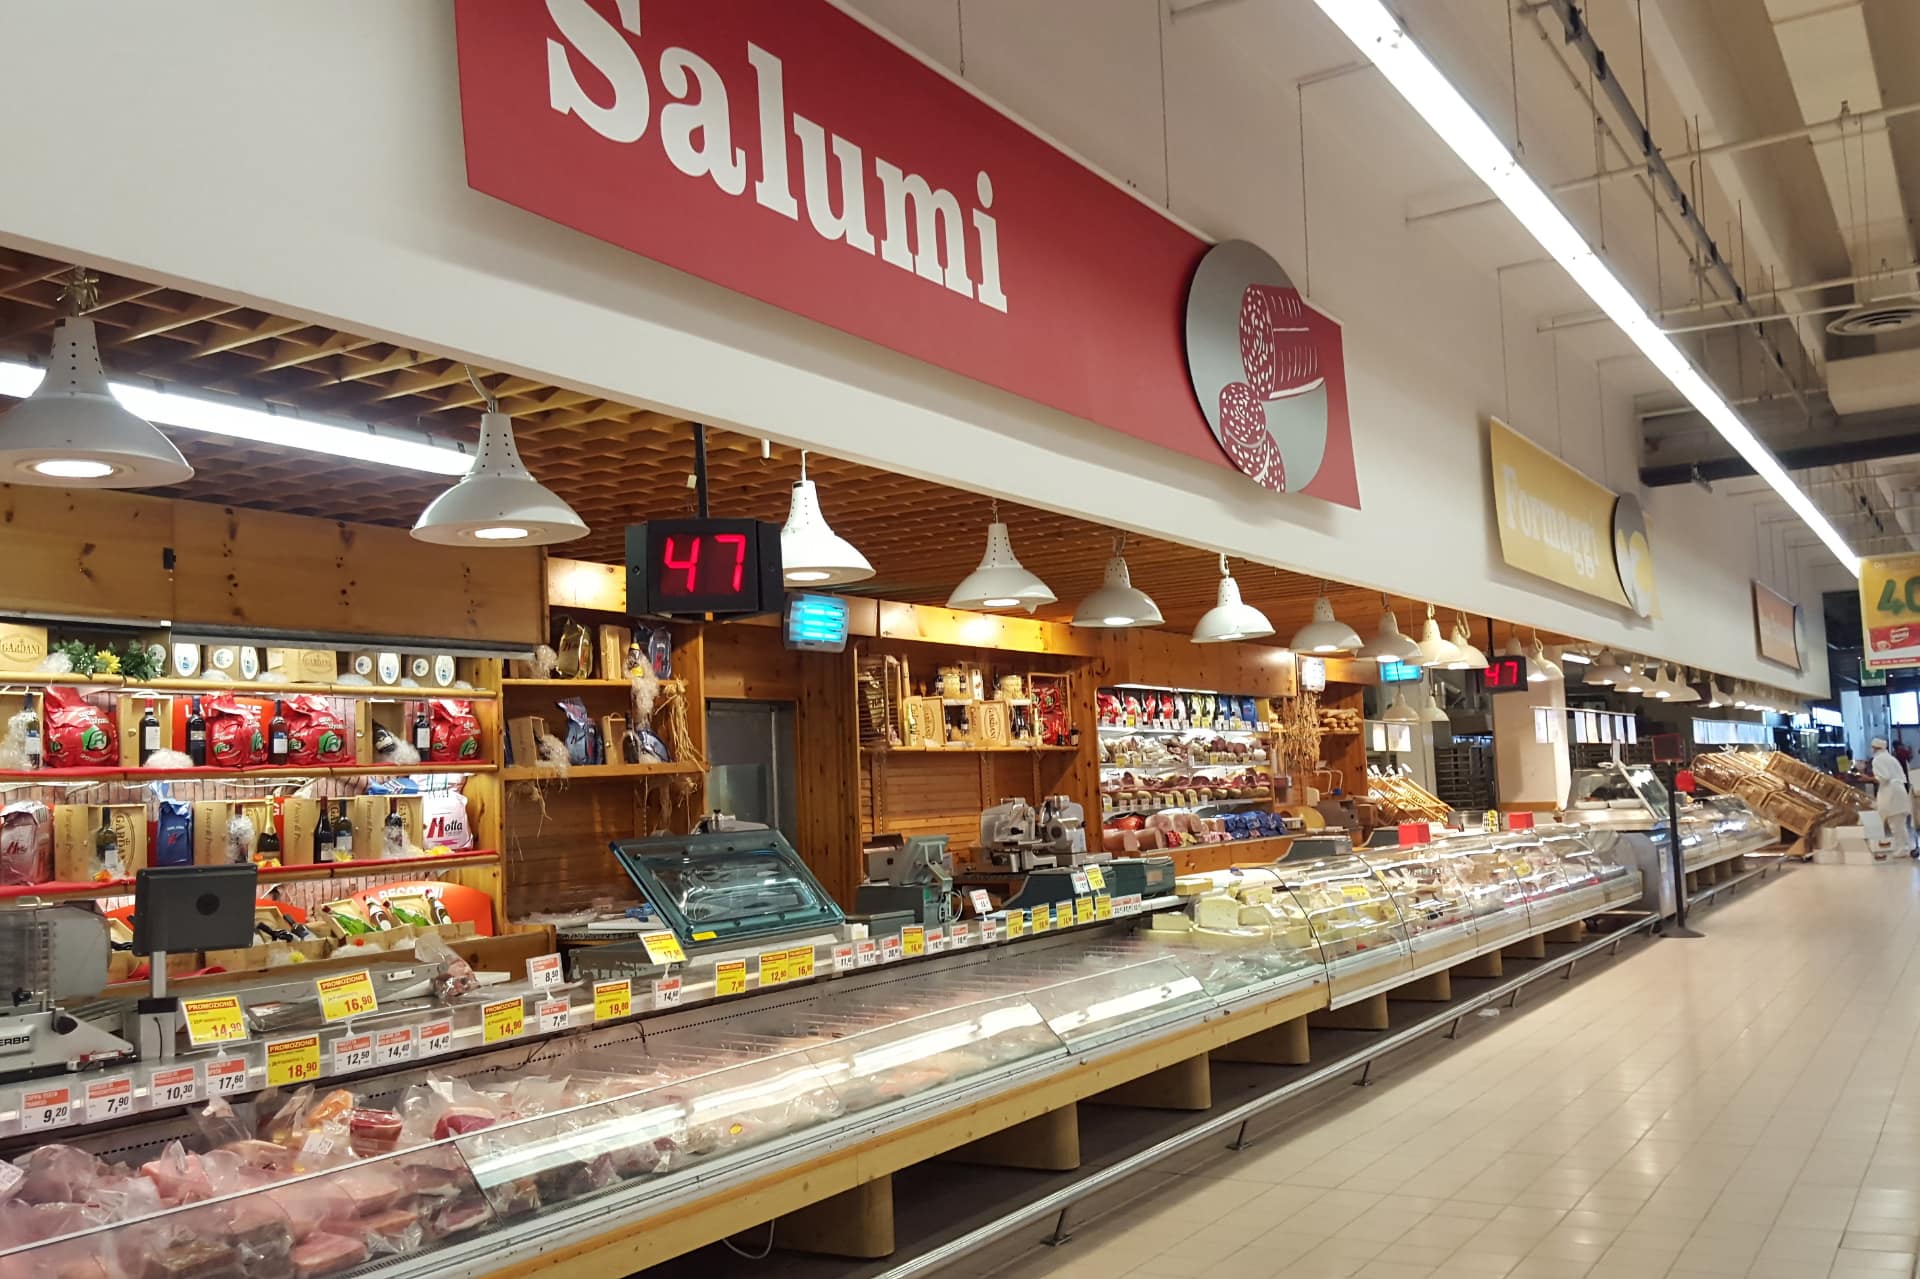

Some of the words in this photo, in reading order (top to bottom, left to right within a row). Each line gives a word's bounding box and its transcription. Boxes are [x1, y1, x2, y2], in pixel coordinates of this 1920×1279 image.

[545, 0, 1008, 313] Salumi
[664, 533, 746, 593] 47
[1484, 661, 1519, 688] 47
[321, 973, 366, 990] PROMOZIONE
[187, 1000, 235, 1011] PROMOZIONE
[344, 995, 373, 1012] 16,90
[211, 1022, 241, 1039] 14,90
[499, 1020, 522, 1037] 14,90
[269, 1038, 315, 1053] PROMOZIONE
[347, 1050, 370, 1065] 12,50
[287, 1061, 317, 1079] 18,90
[218, 1074, 244, 1090] 17,60
[166, 1084, 193, 1100] 10,30
[107, 1096, 129, 1113] 7,90
[43, 1106, 68, 1124] 9,20
